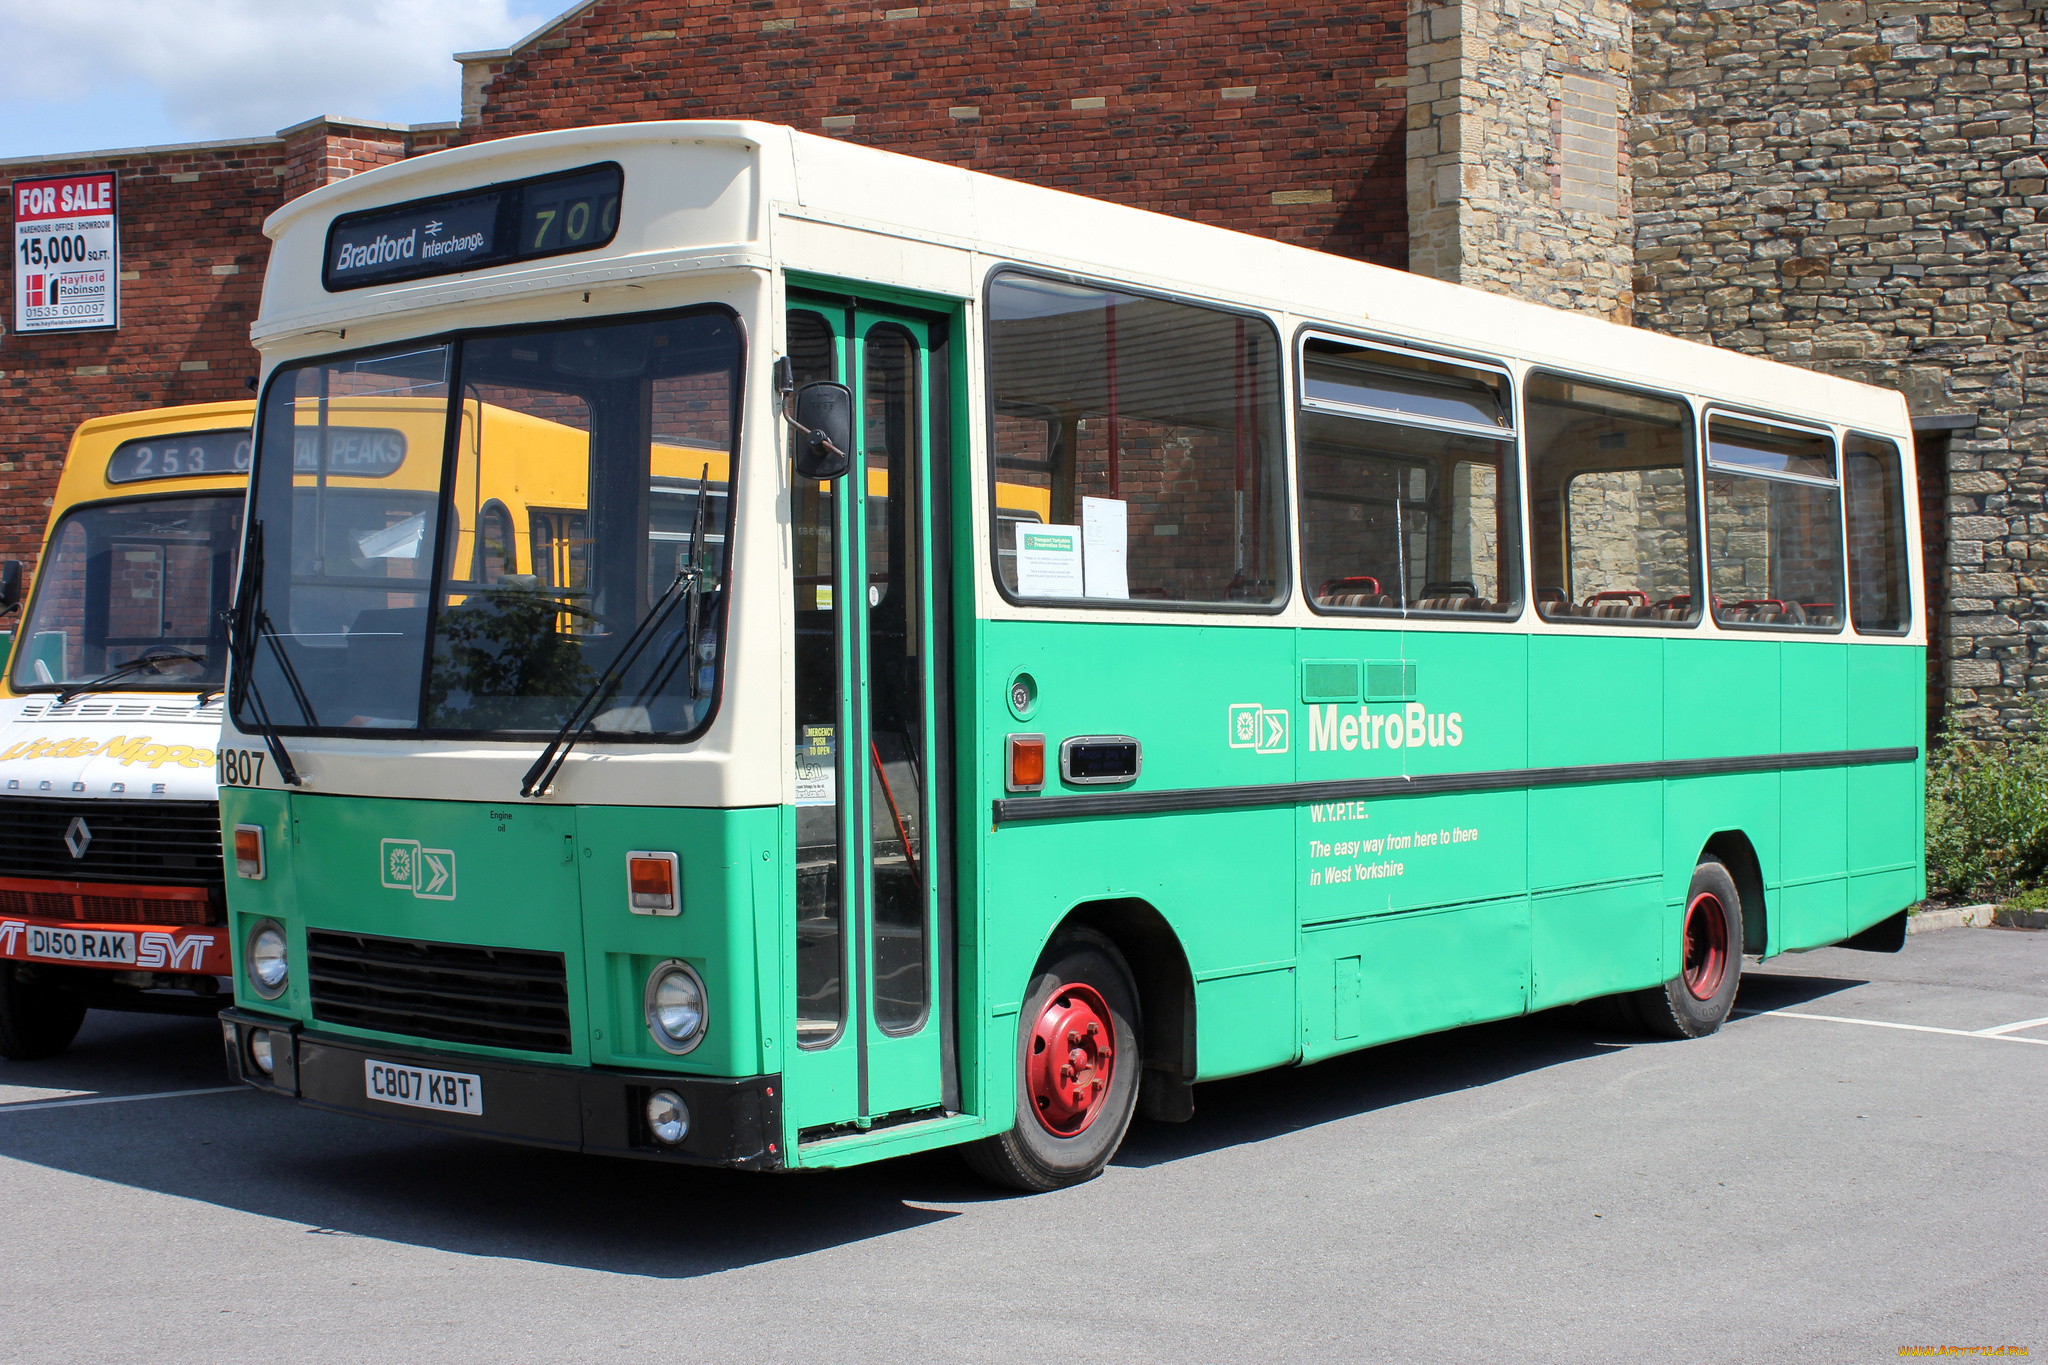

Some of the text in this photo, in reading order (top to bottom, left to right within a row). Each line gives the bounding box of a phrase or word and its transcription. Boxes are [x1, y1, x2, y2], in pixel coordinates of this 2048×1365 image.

[19, 182, 111, 216] FOR SALE
[19, 220, 110, 234] WAREHOUSE OFFICE SHOWROOM
[20, 234, 110, 270] 15,000 SQ.FT.
[336, 229, 484, 271] Bradford Interchange
[60, 273, 105, 286] Hayfield
[60, 284, 105, 295] Robinson
[26, 303, 105, 317] 01535 600097
[26, 317, 104, 328] www.hayfieldrobinson.co.uk
[136, 446, 205, 474] 253
[332, 435, 401, 465] PEAKS
[1308, 702, 1464, 752] MetroBus
[0, 736, 99, 762] Little
[809, 746, 831, 755] TO OPEN
[812, 737, 827, 746] PUSH
[217, 748, 265, 786] 1807
[490, 810, 513, 822] Engine
[1310, 801, 1369, 823] W.Y.P.T.E.
[497, 824, 506, 833] oil
[1309, 826, 1479, 859] The easy way from here to there
[1310, 859, 1404, 886] in West Yorkshire
[82, 934, 127, 959] RAK
[136, 931, 215, 970] SYT
[372, 1065, 471, 1108] C807 KBT
